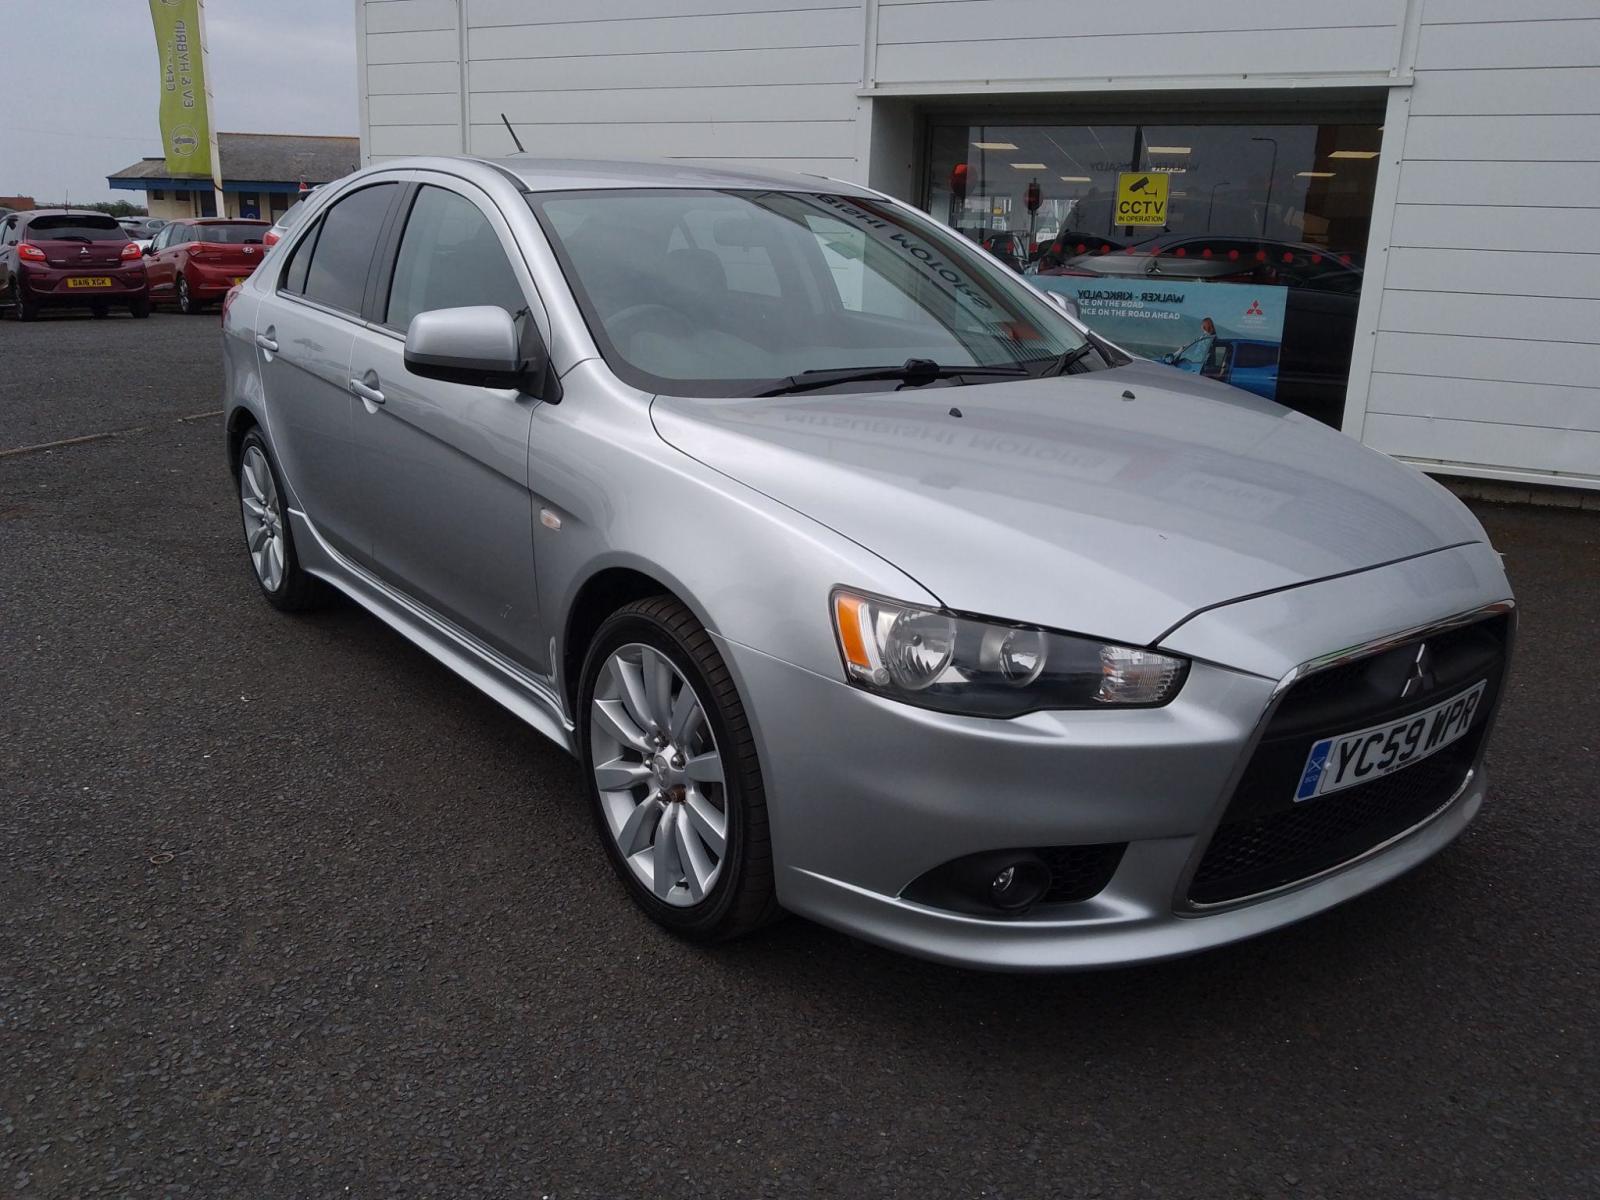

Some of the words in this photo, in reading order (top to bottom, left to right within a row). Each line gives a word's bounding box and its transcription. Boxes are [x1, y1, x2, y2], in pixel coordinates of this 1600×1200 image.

[1119, 201, 1164, 214] CCTV
[1091, 299, 1103, 307] ON
[1104, 300, 1120, 308] THE
[1120, 301, 1144, 309] ROAD
[1098, 308, 1110, 316] ON
[1111, 309, 1128, 317] THE
[1128, 310, 1151, 318] ROAD
[1151, 311, 1181, 320] AHEAD
[1334, 718, 1426, 784] YC59
[1424, 689, 1481, 751] WPR
